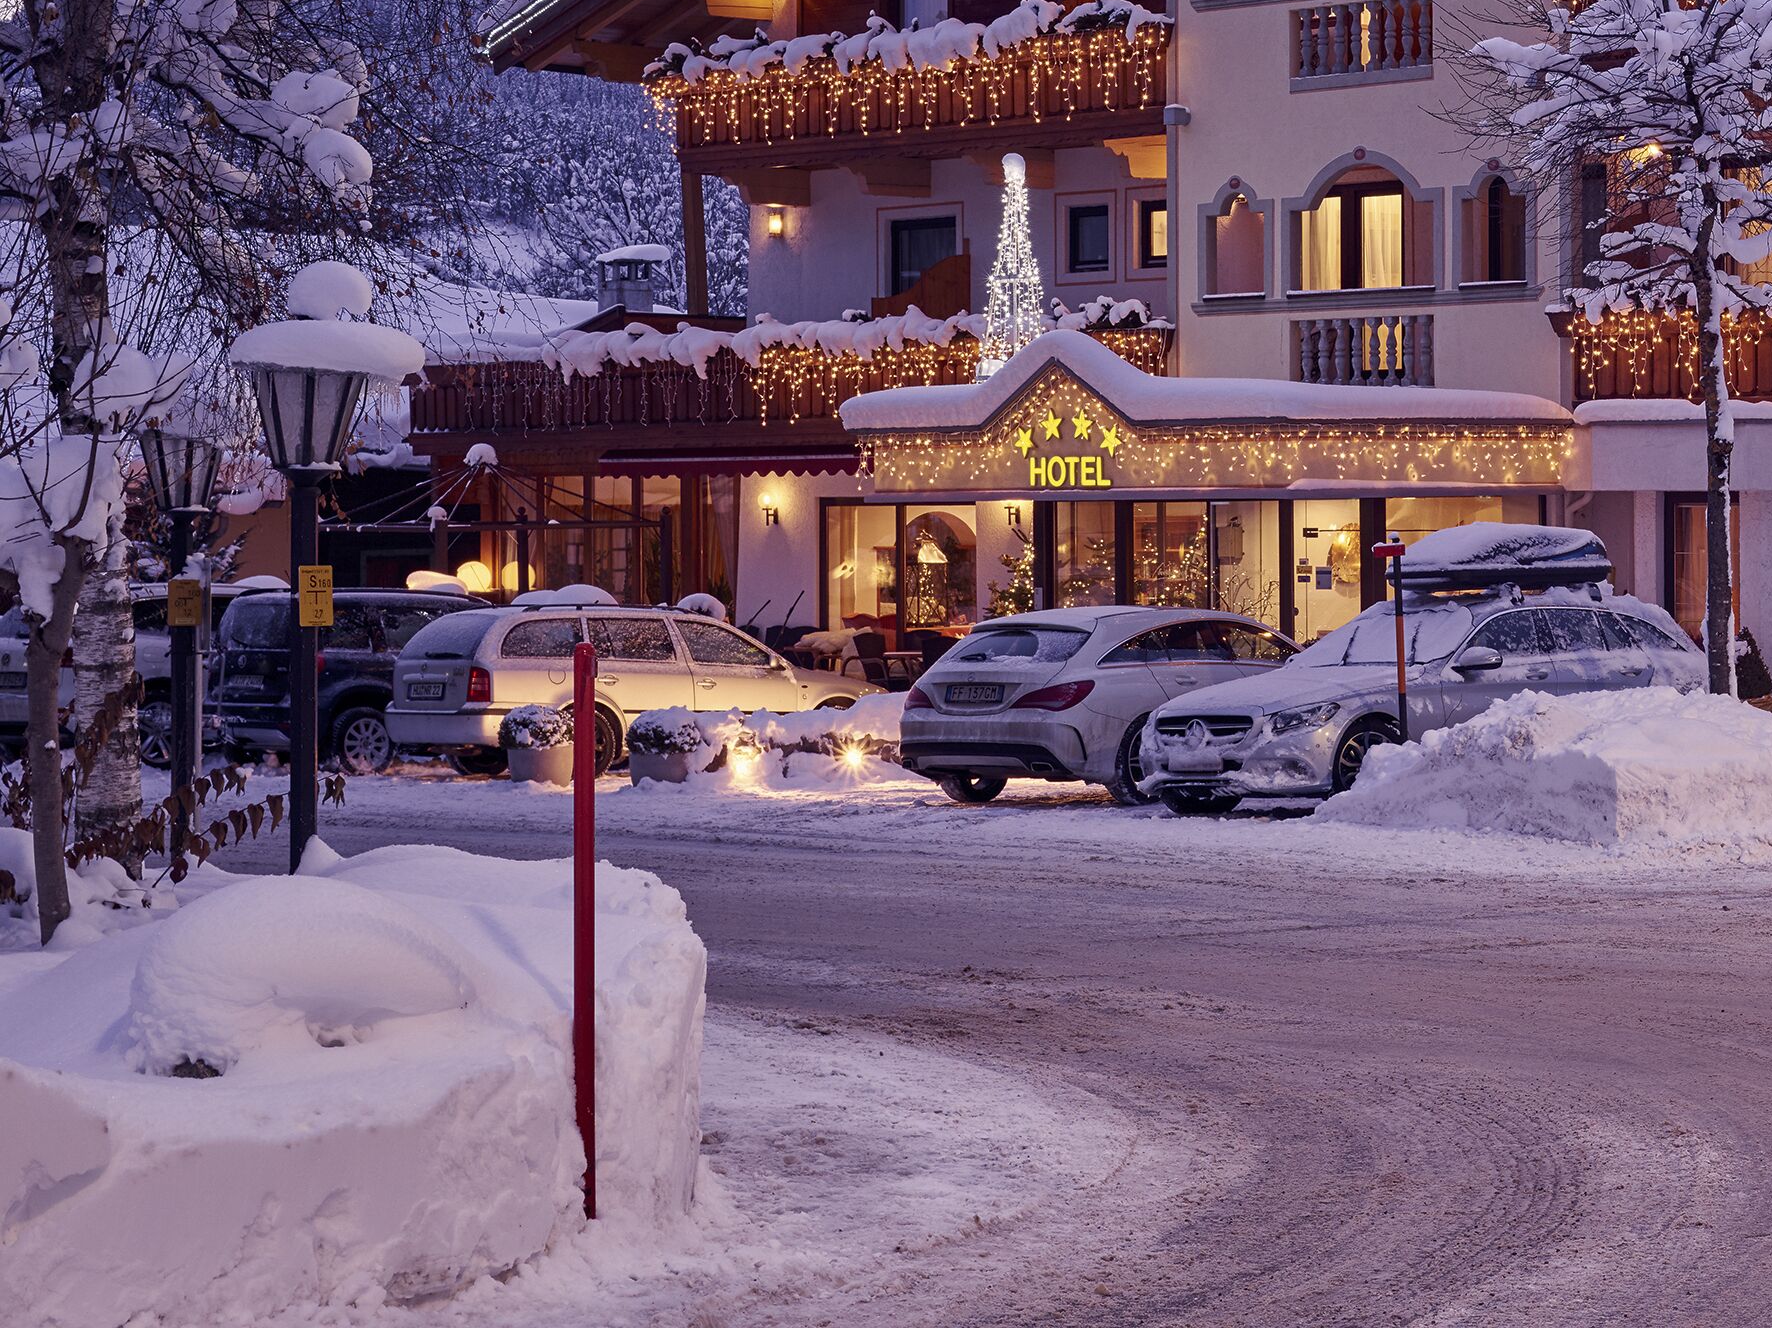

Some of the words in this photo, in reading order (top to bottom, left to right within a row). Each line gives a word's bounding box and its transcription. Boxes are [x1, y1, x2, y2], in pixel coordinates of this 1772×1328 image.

[1029, 455, 1112, 487] HOTEL
[309, 574, 317, 588] S
[318, 578, 332, 588] 160
[432, 685, 441, 695] 22
[951, 687, 965, 699] FF
